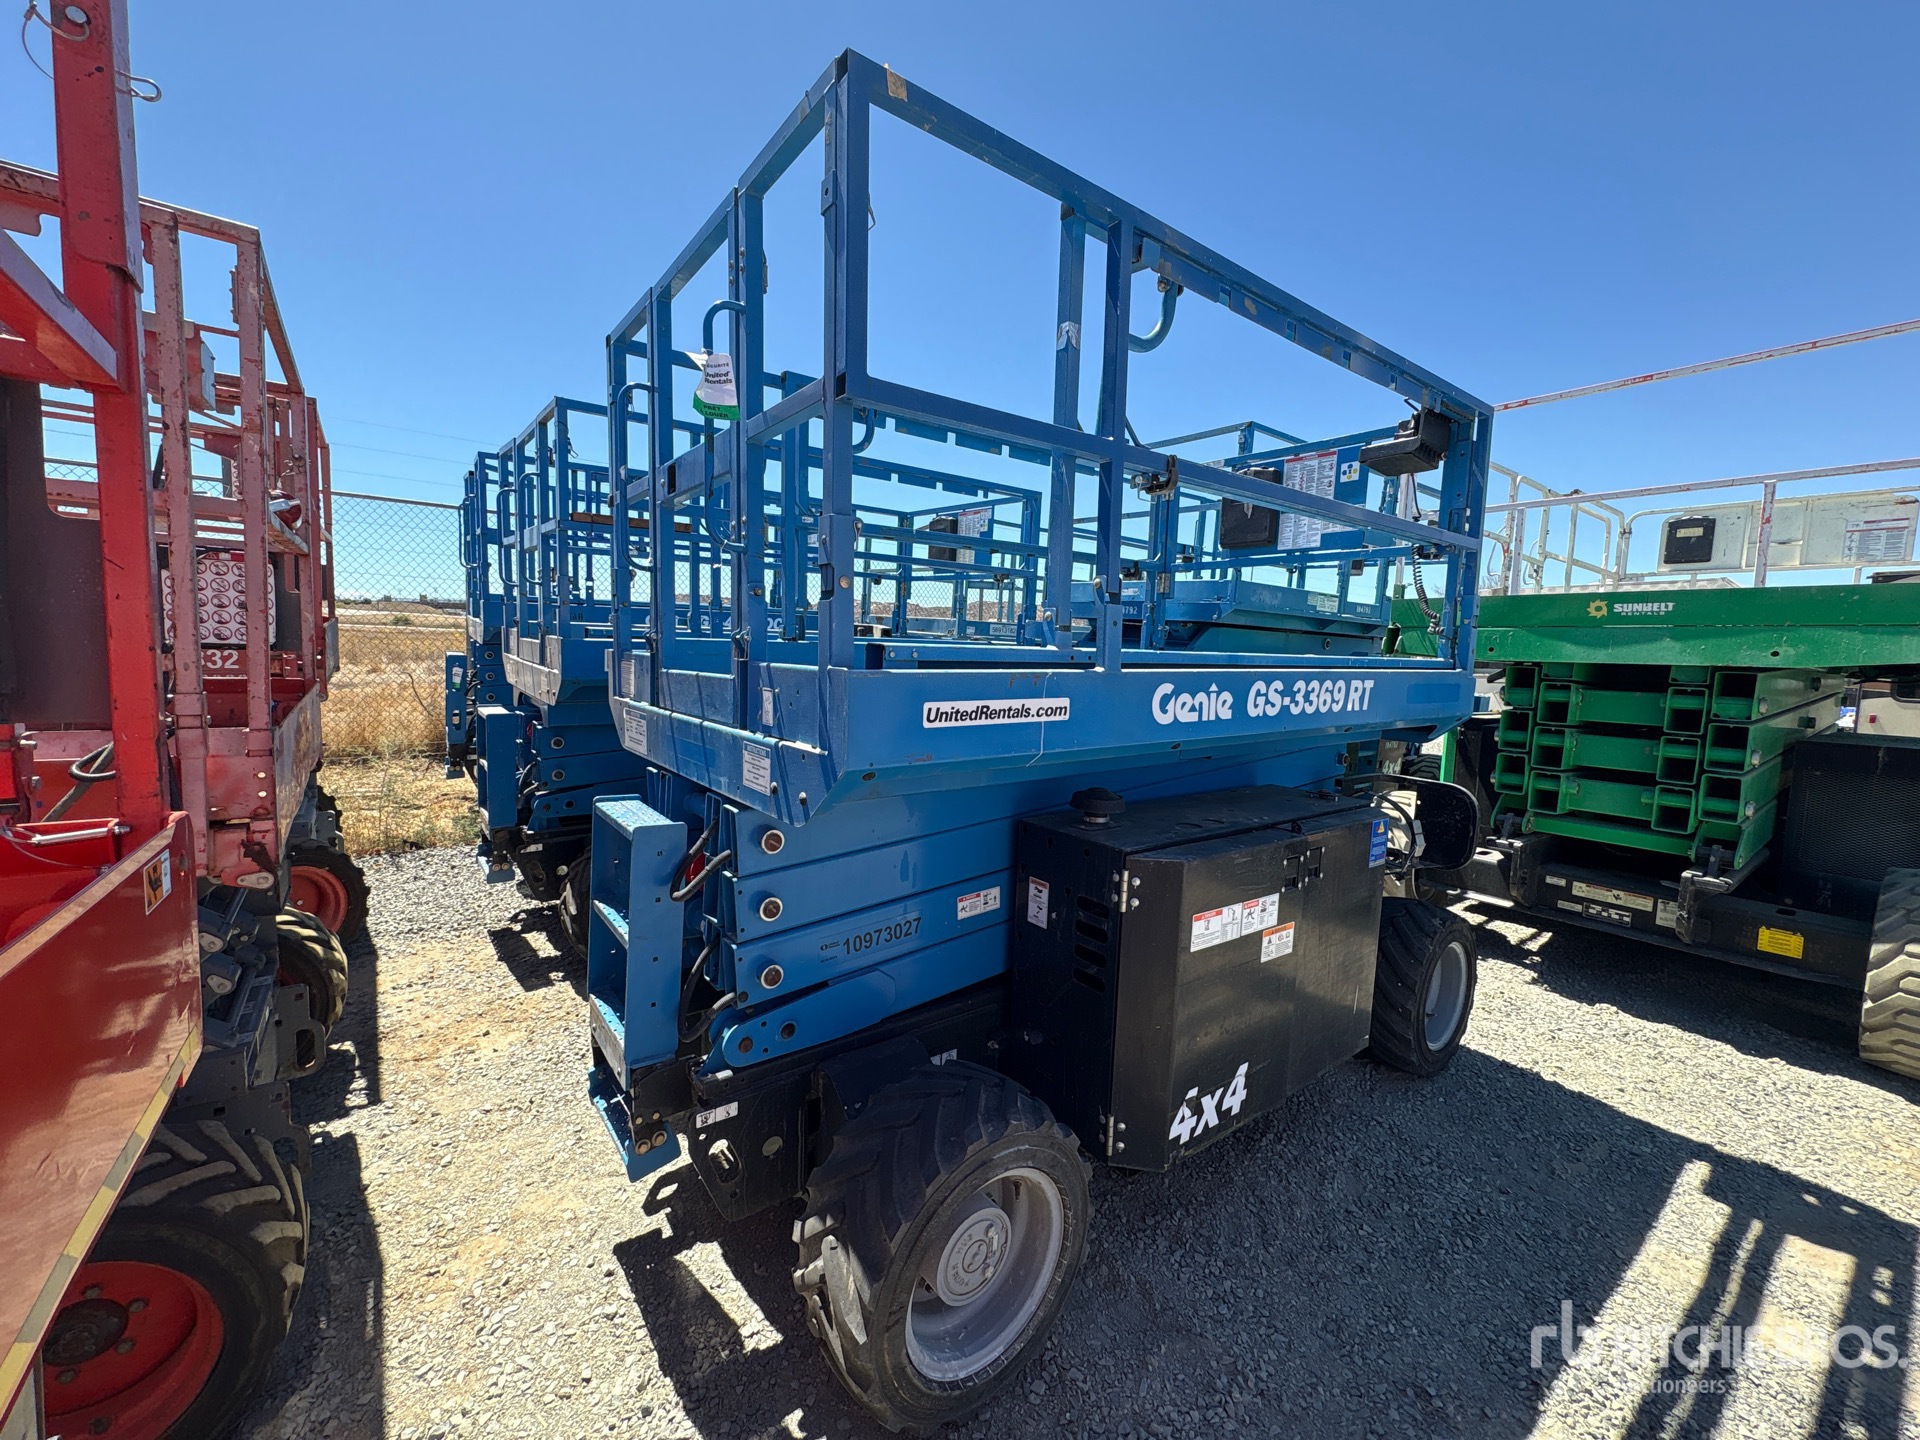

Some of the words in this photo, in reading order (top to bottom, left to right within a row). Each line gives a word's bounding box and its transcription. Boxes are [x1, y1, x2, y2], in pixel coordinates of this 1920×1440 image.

[705, 371, 730, 379] United
[1613, 602, 1676, 612] SUNBELT
[201, 649, 239, 669] 32
[926, 703, 1068, 723] UnitedRentals.com
[1152, 682, 1234, 725] Genie
[843, 917, 922, 955] 10973027
